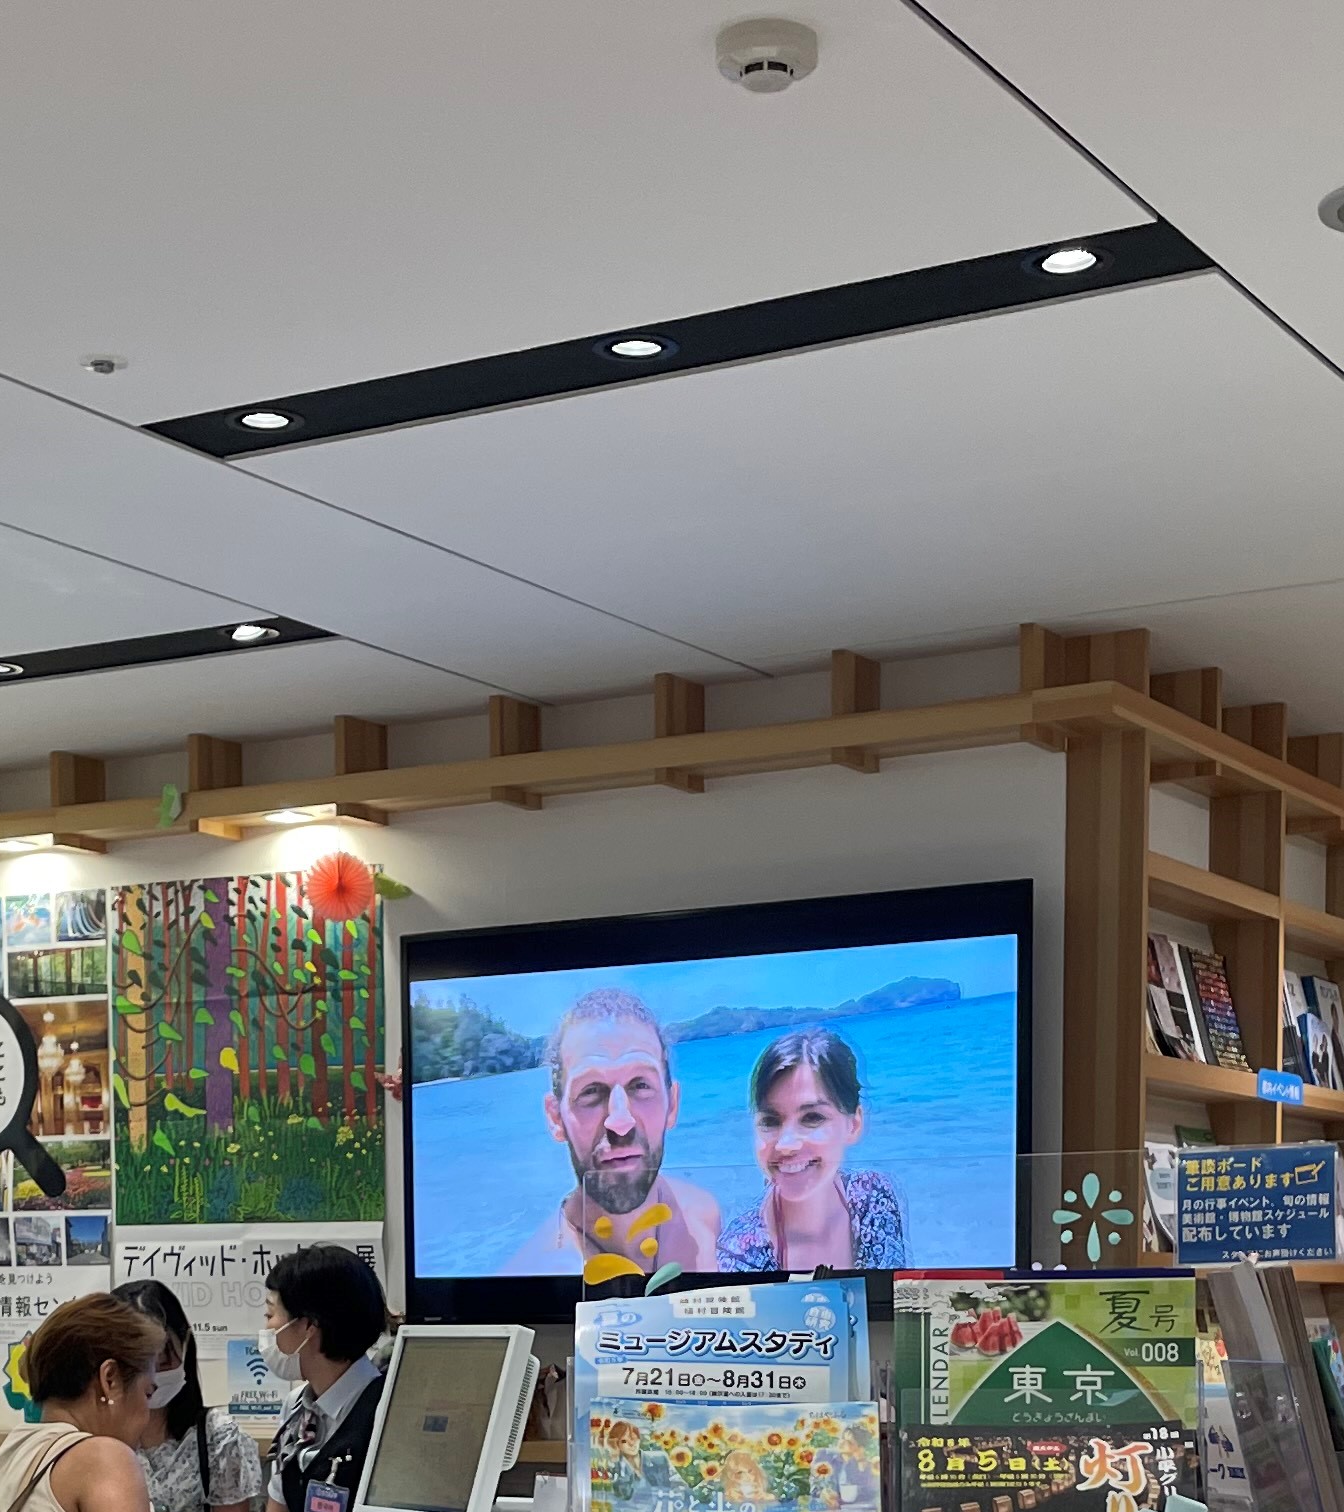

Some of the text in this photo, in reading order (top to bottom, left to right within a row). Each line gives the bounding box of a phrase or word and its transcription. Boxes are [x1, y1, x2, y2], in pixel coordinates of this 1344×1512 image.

[1186, 1173, 1294, 1192] ご用意あります
[1182, 1223, 1291, 1243] 配布しています
[599, 1330, 836, 1355] ミュージアムスタディ
[1141, 1343, 1179, 1362] 008
[1004, 1364, 1115, 1405] 東京
